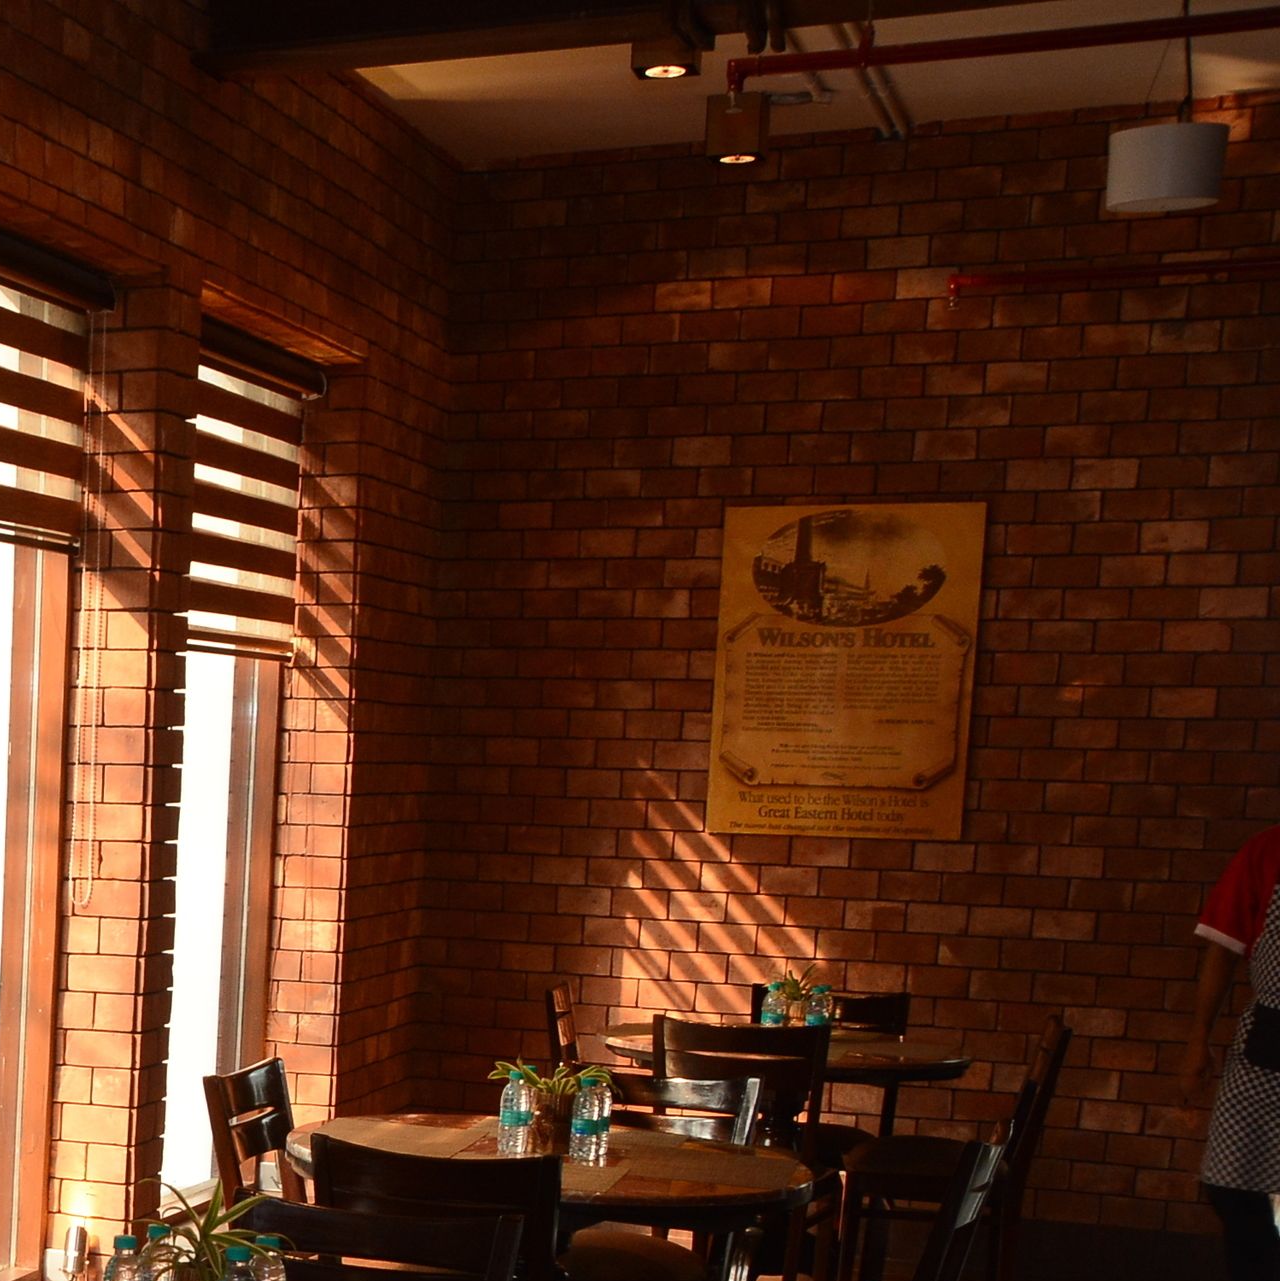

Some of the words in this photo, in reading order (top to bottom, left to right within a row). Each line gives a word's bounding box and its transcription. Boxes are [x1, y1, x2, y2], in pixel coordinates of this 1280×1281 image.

[757, 628, 856, 647] WILSON'S
[863, 629, 936, 647] HOTEL
[738, 792, 763, 802] What
[767, 792, 791, 803] used
[794, 794, 805, 803] to
[808, 793, 822, 804] be
[823, 794, 840, 804] the
[888, 796, 917, 806] Hotel
[920, 799, 929, 807] is
[758, 806, 790, 817] Great
[795, 807, 837, 819] Eastern
[841, 808, 873, 820] Hotel
[877, 810, 905, 823] today
